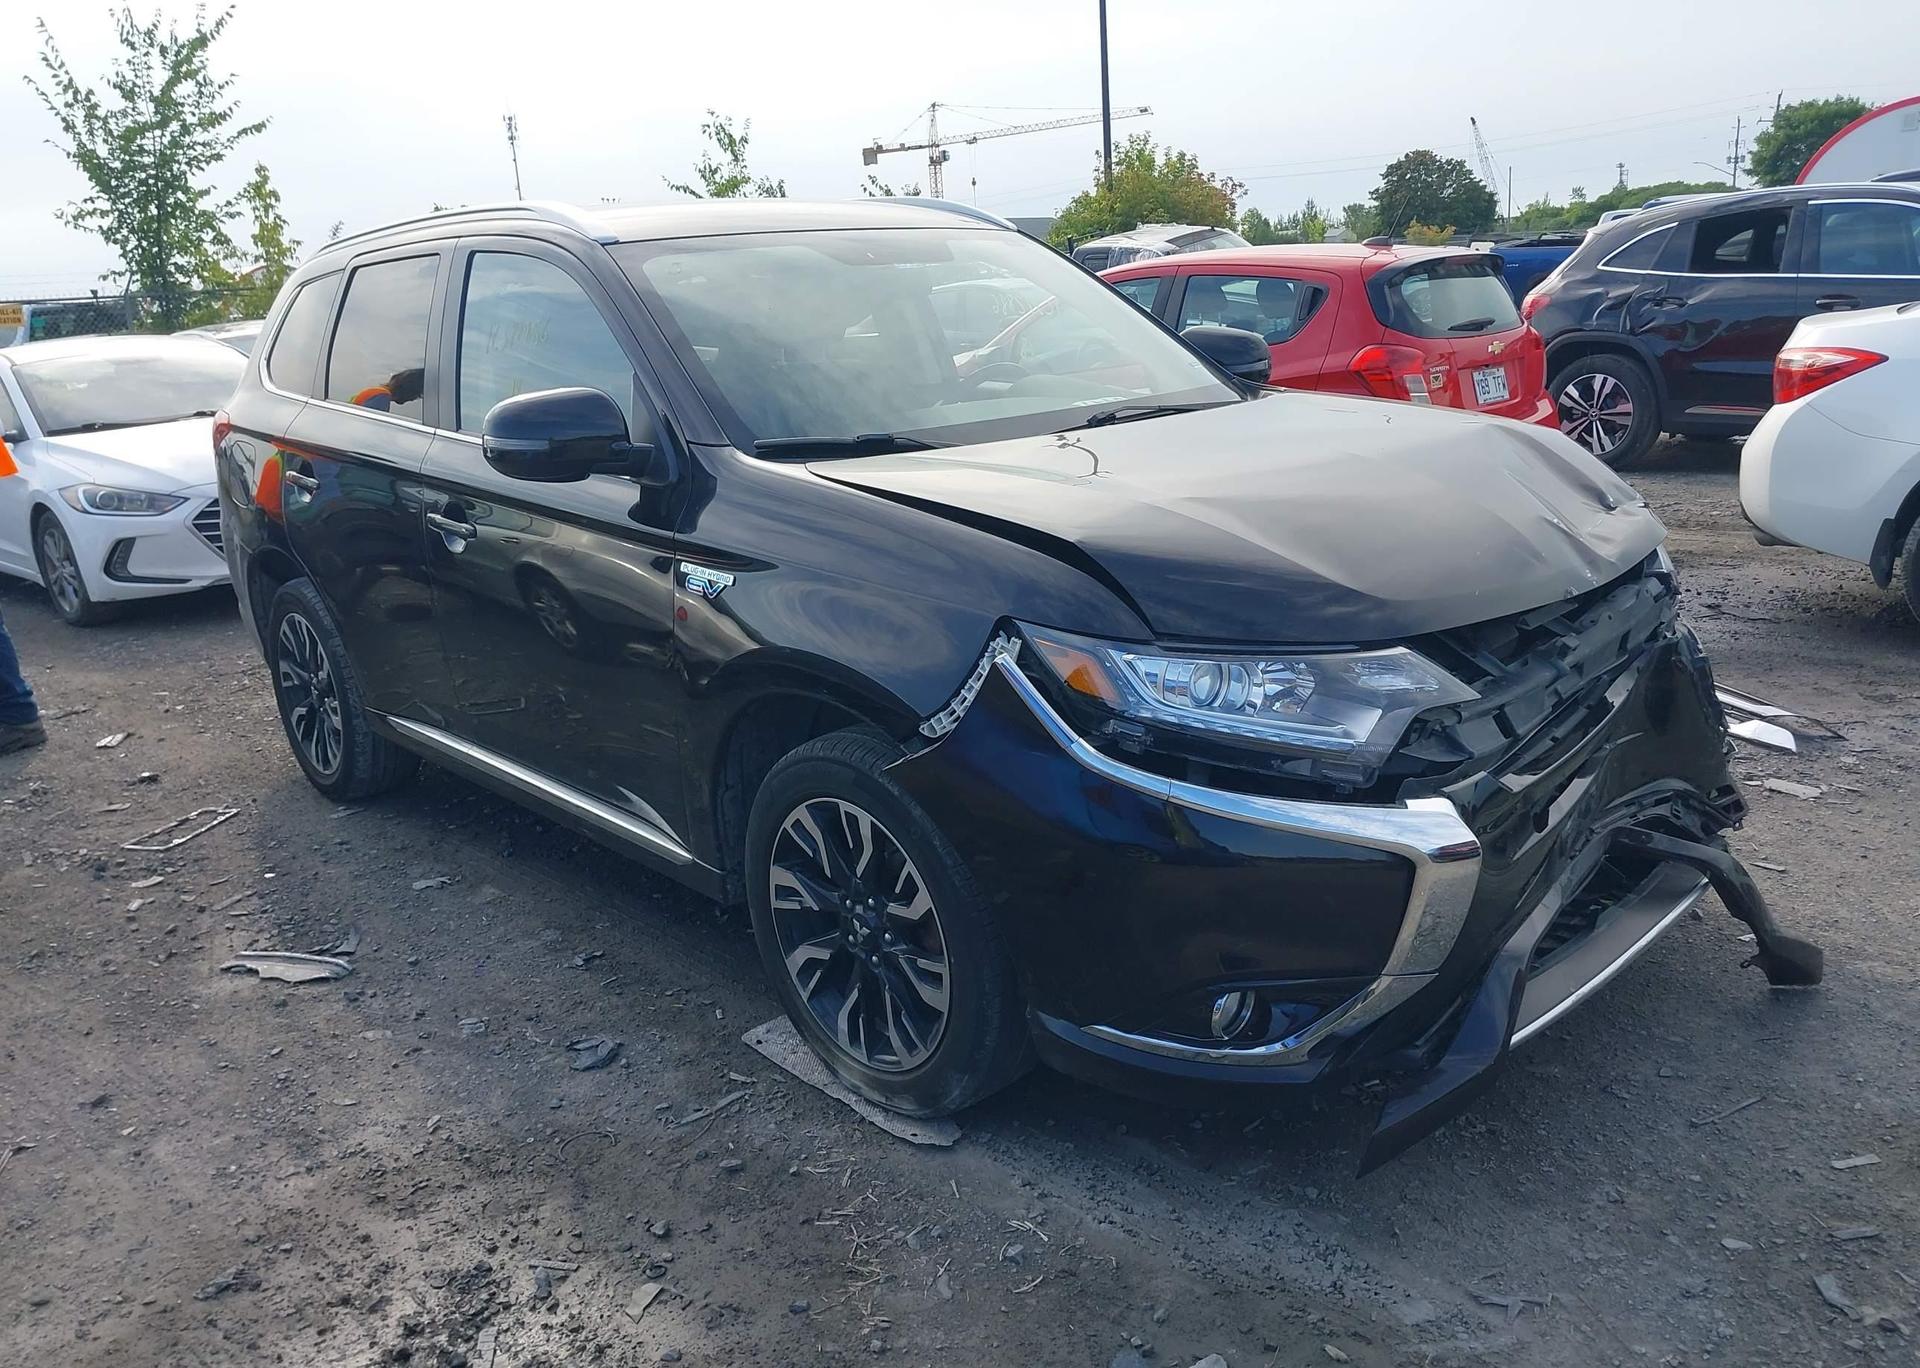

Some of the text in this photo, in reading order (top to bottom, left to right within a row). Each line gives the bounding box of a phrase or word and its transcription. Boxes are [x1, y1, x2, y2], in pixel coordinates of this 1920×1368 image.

[682, 563, 731, 584] PLUG-IN HYBRID
[685, 574, 725, 598] EV
